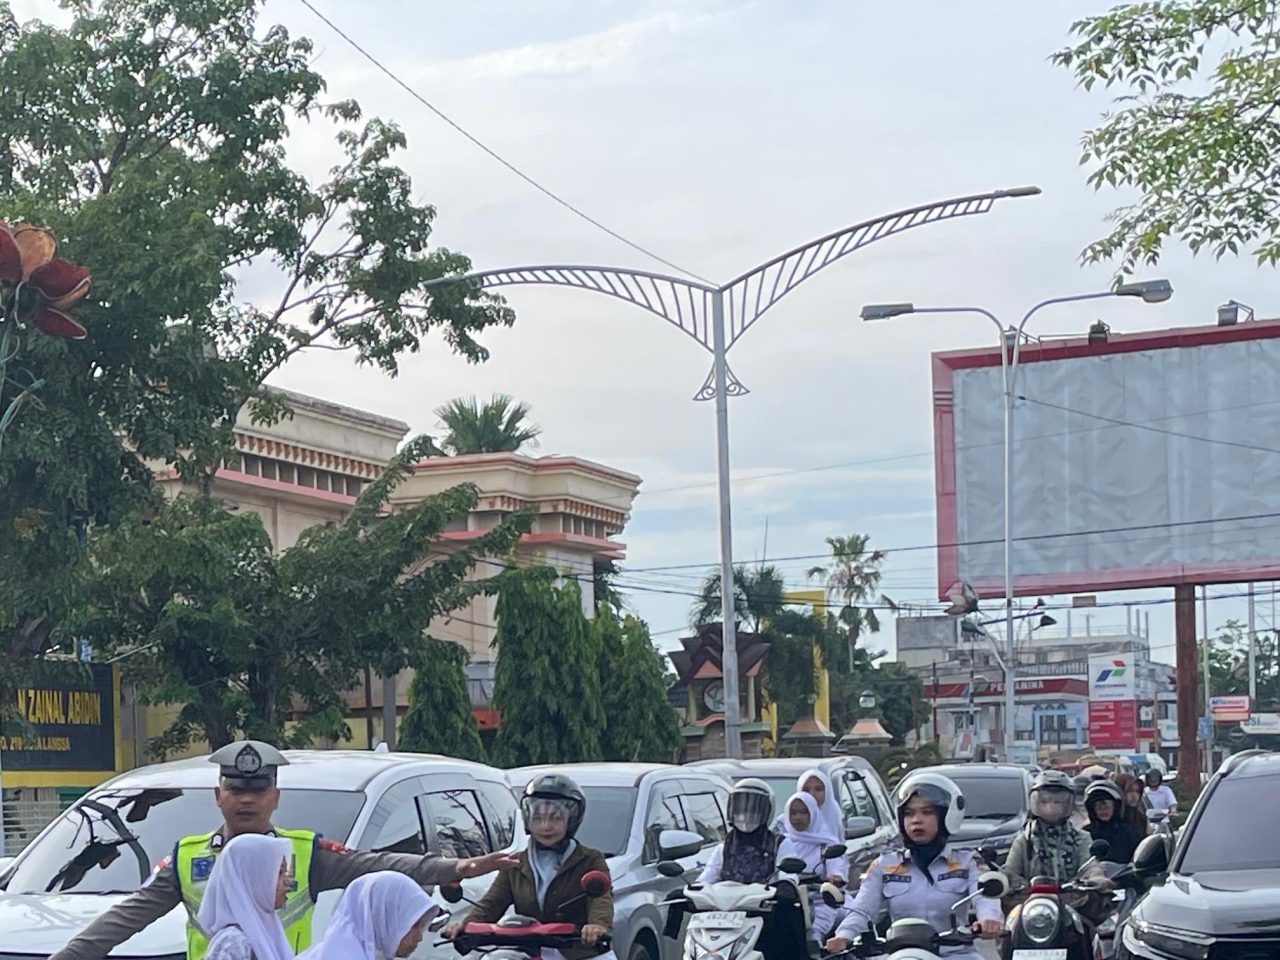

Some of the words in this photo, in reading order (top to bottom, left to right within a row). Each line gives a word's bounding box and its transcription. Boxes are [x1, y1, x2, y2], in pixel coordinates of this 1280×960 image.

[990, 680, 1044, 693] PEAMINA
[28, 689, 66, 725] ZAINAL
[67, 691, 102, 726] ABIDIN
